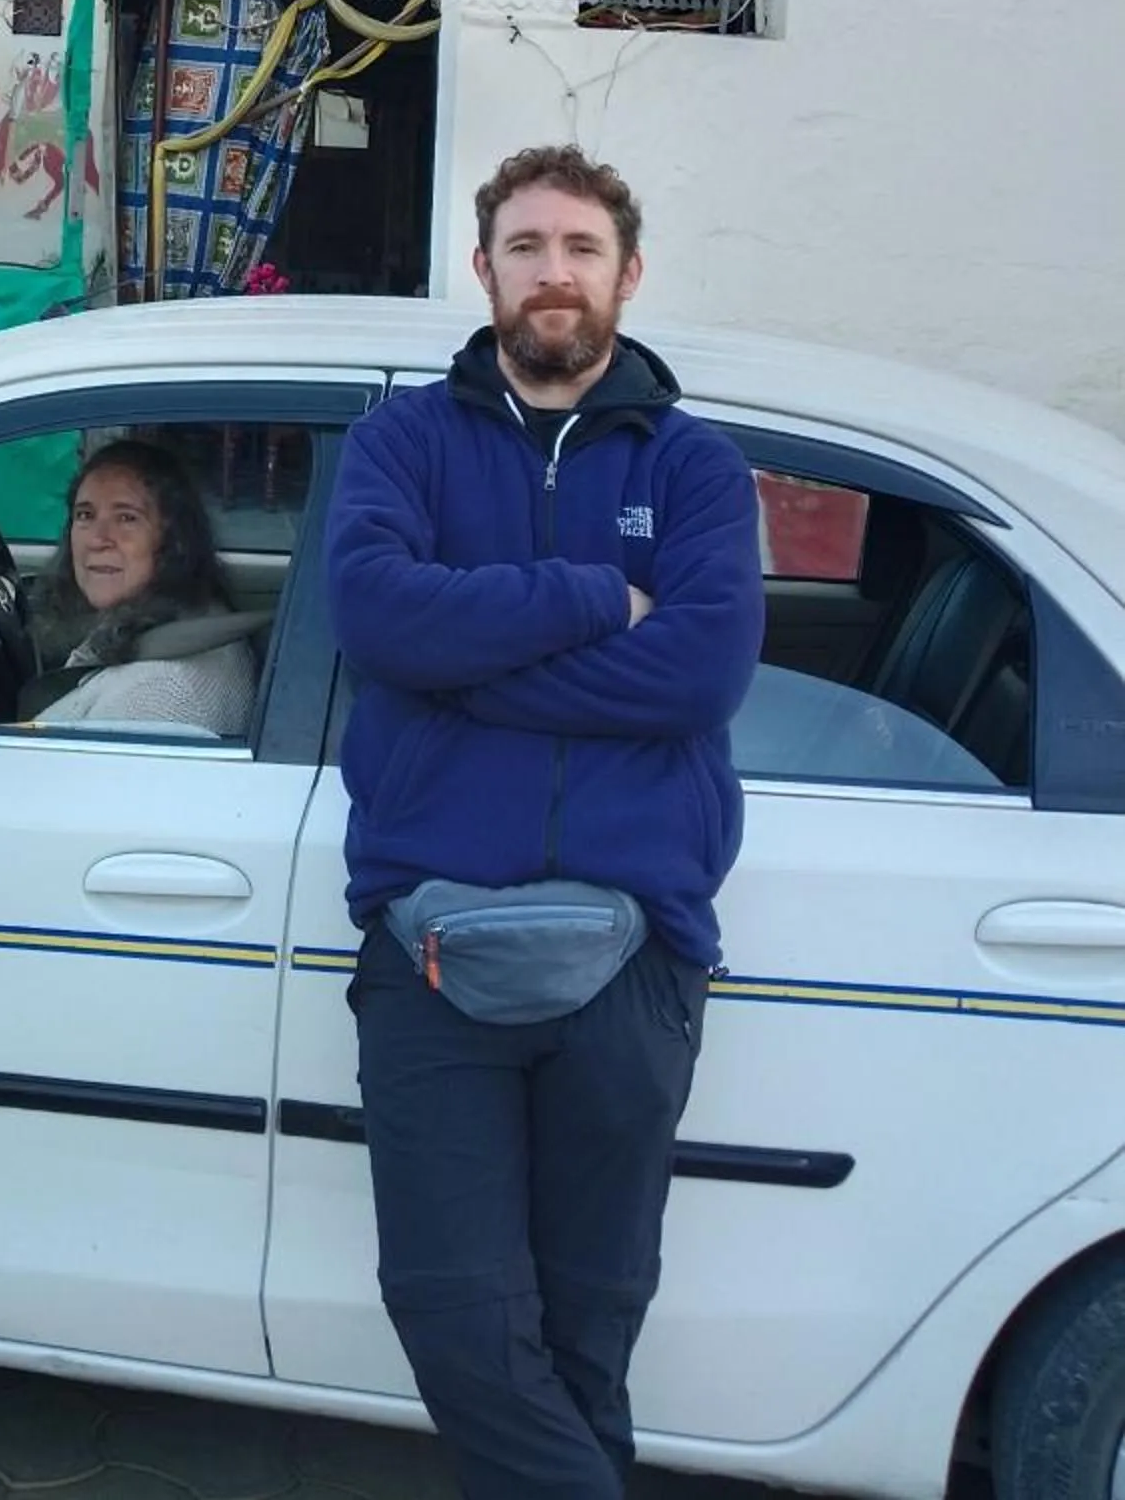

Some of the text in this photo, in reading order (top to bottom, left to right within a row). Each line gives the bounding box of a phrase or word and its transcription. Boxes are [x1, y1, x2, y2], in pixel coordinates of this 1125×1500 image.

[623, 507, 645, 517] THE
[616, 517, 645, 527] ORTH
[620, 527, 646, 537] FACE
